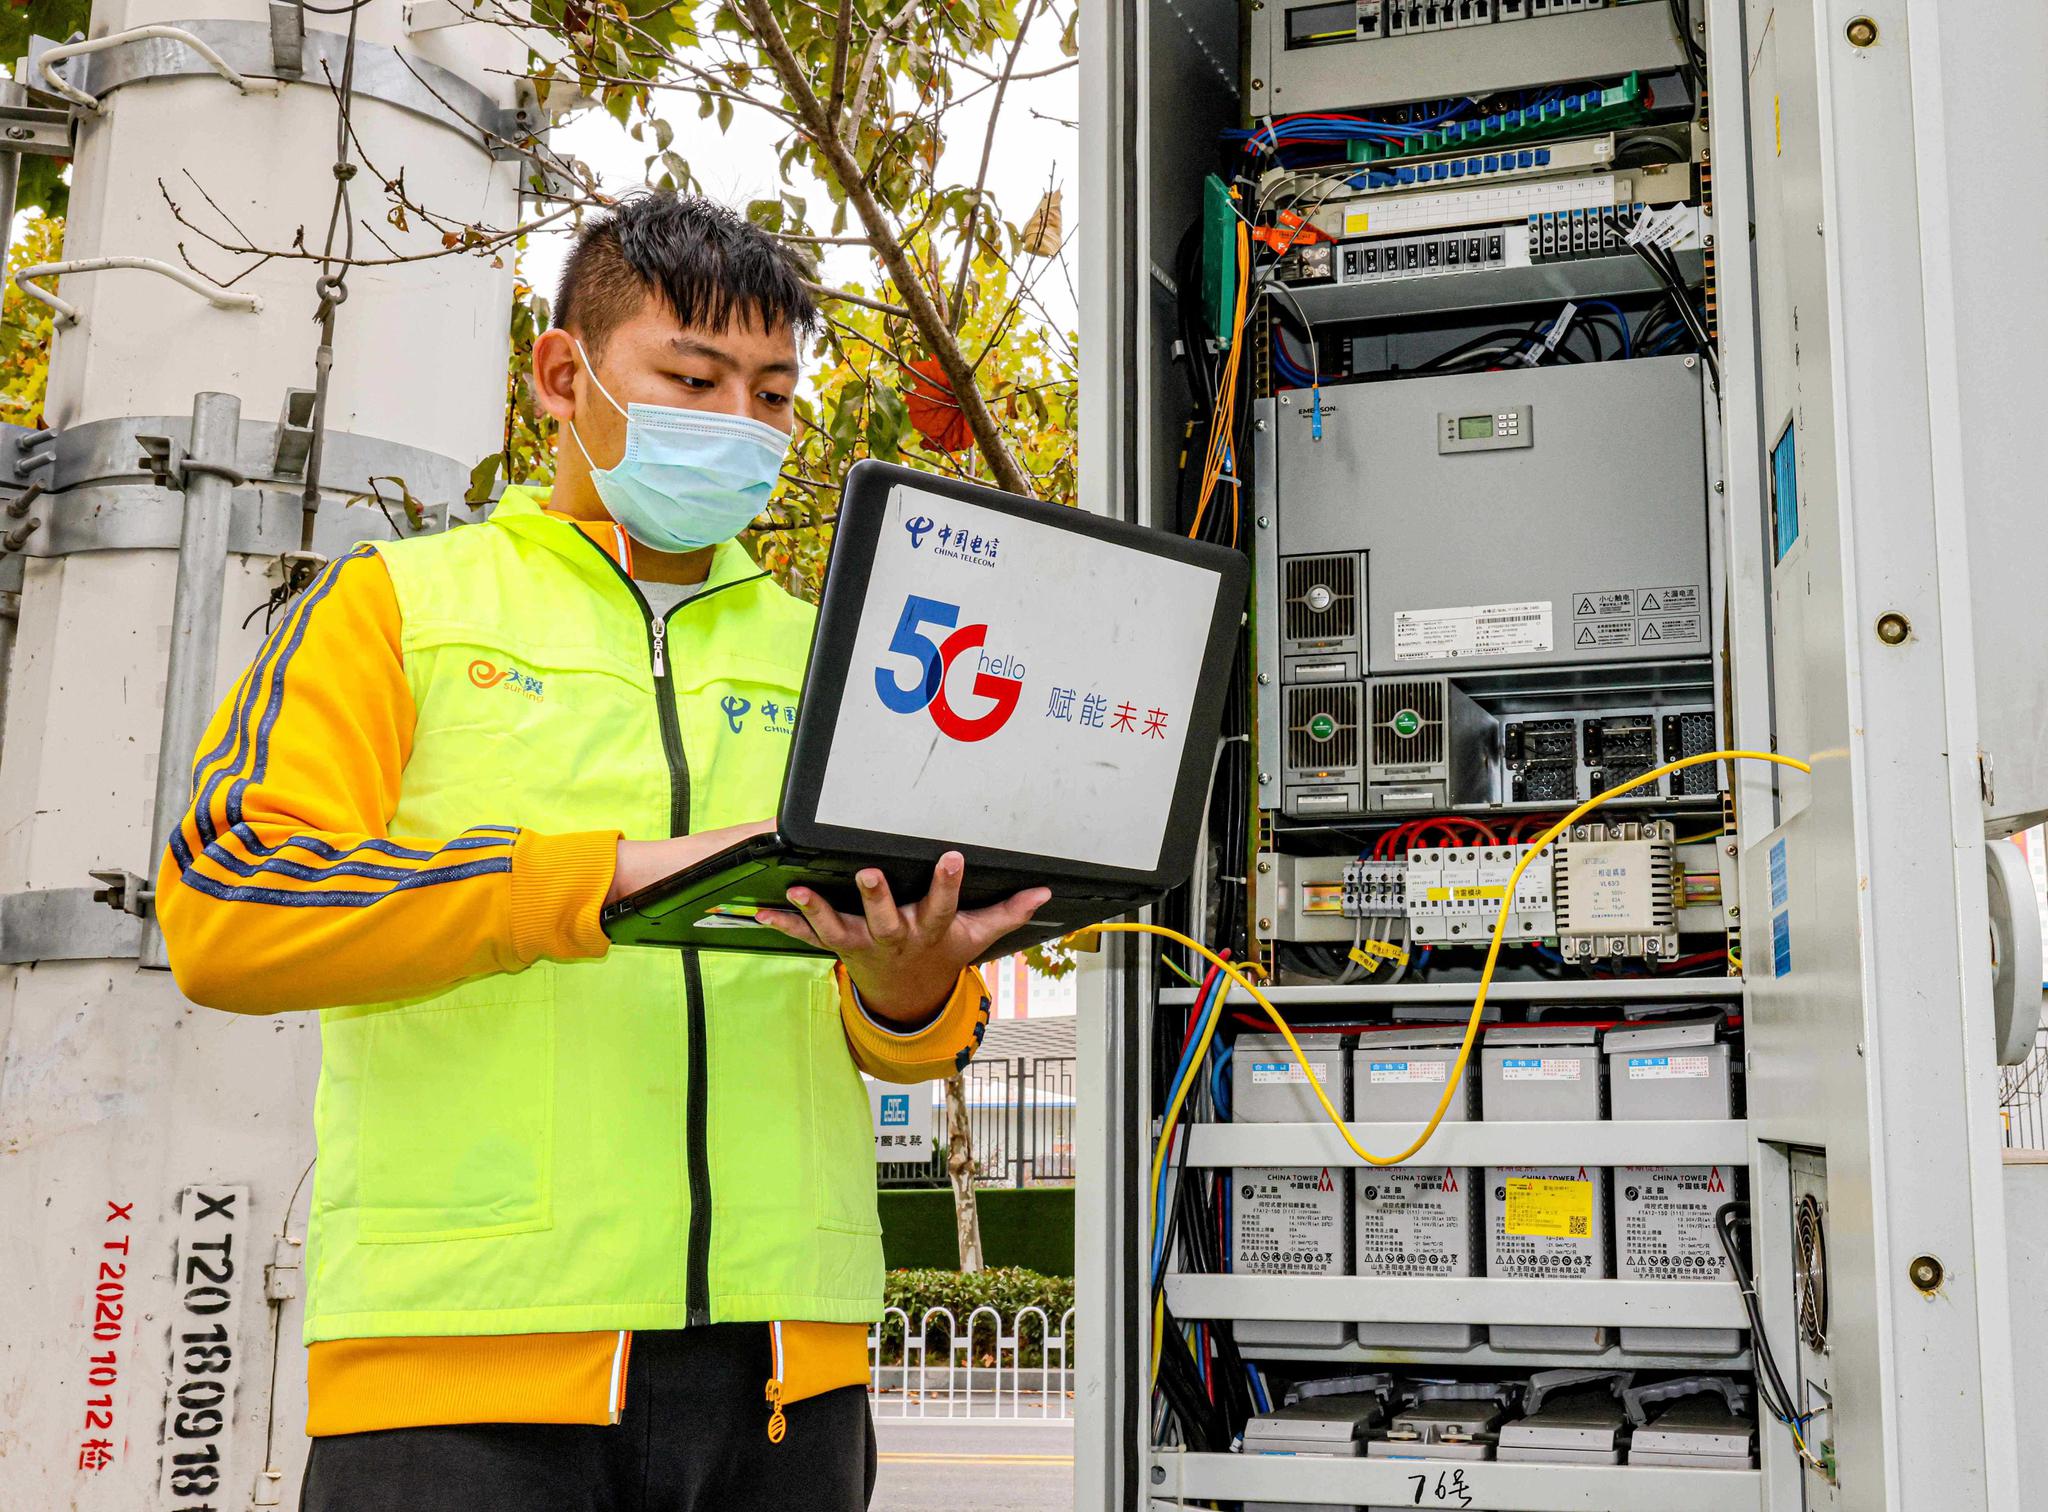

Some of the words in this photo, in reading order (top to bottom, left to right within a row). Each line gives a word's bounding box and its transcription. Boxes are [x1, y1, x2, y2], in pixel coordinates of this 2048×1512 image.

[1298, 406, 1336, 414] EMESON
[938, 524, 1000, 558] 中国电信
[934, 547, 958, 559] CHINA
[960, 553, 995, 568] TELECOM
[875, 594, 1023, 743] 5G
[978, 649, 1026, 680] hello
[503, 683, 544, 703] surfing
[1046, 686, 1169, 740] 赋能未来
